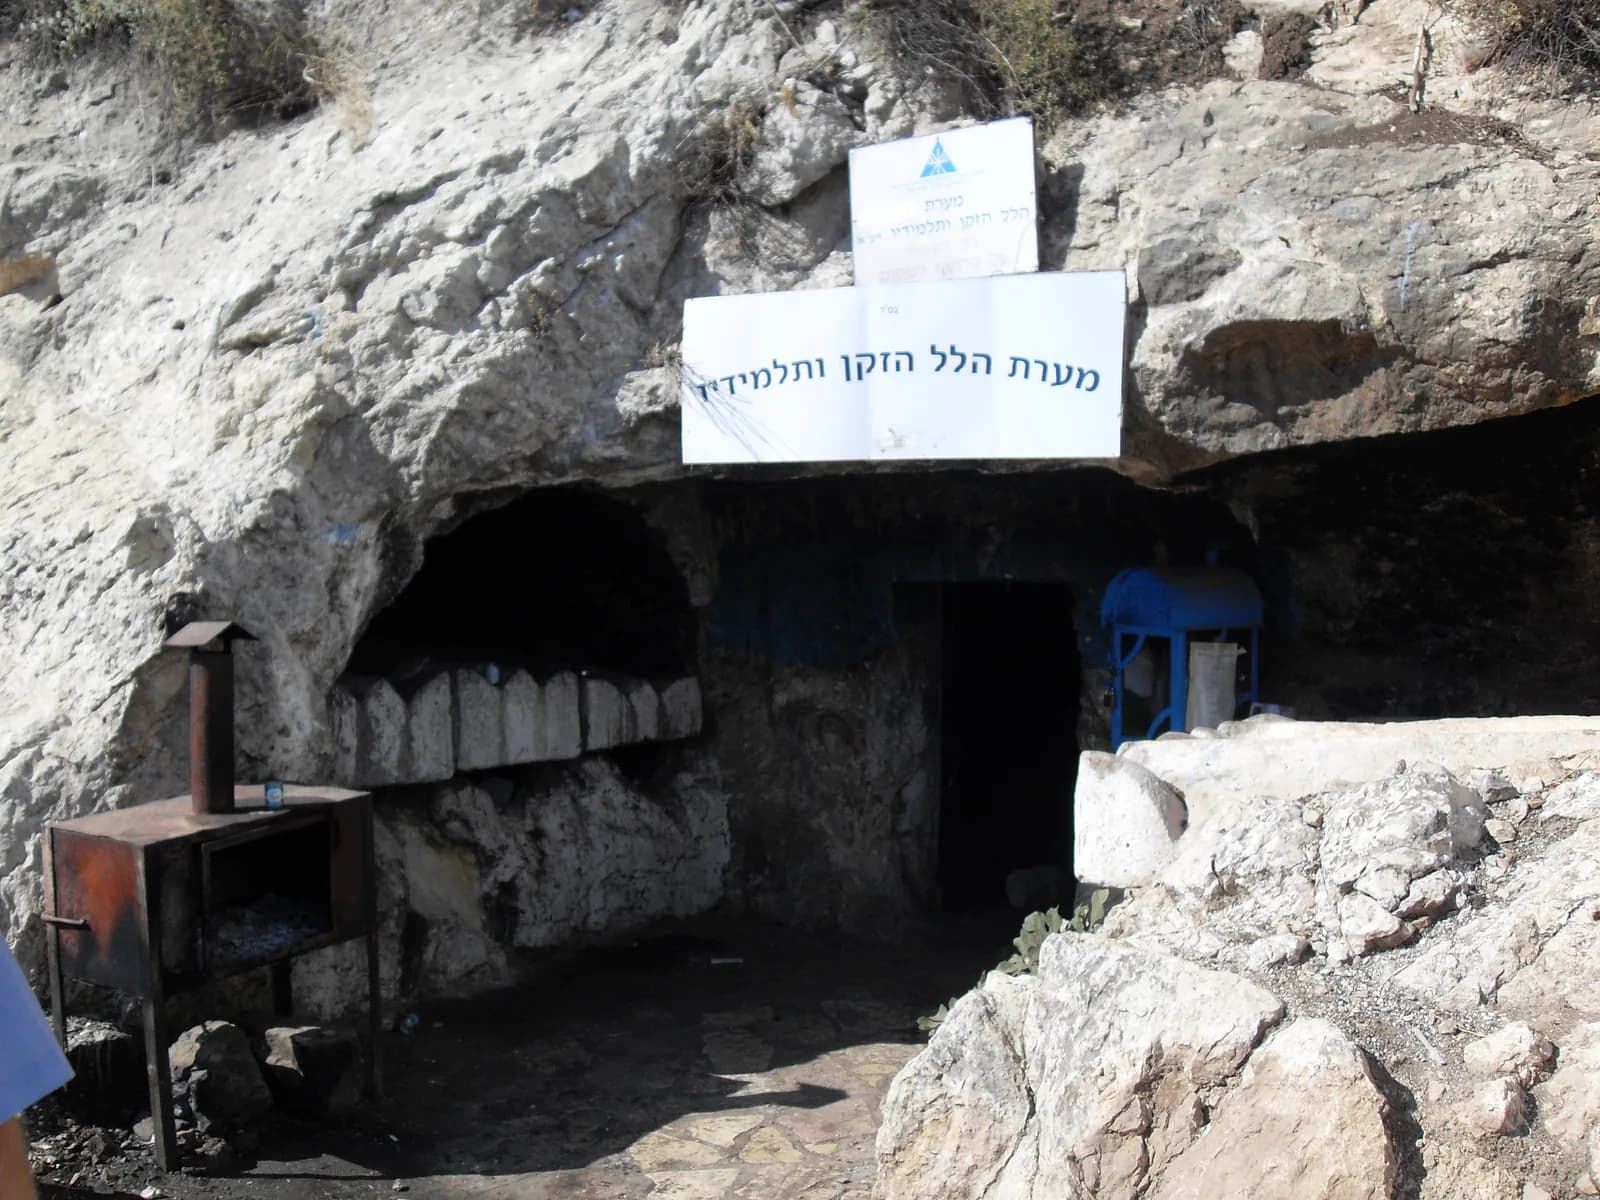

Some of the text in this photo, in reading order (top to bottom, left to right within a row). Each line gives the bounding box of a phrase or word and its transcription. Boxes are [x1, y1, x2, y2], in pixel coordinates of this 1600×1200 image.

[924, 195, 964, 212] מערת
[960, 211, 992, 232] הזקן
[1000, 207, 1030, 224] הלל
[697, 344, 1101, 402] מערת הלל הזקן ותלמידיו
